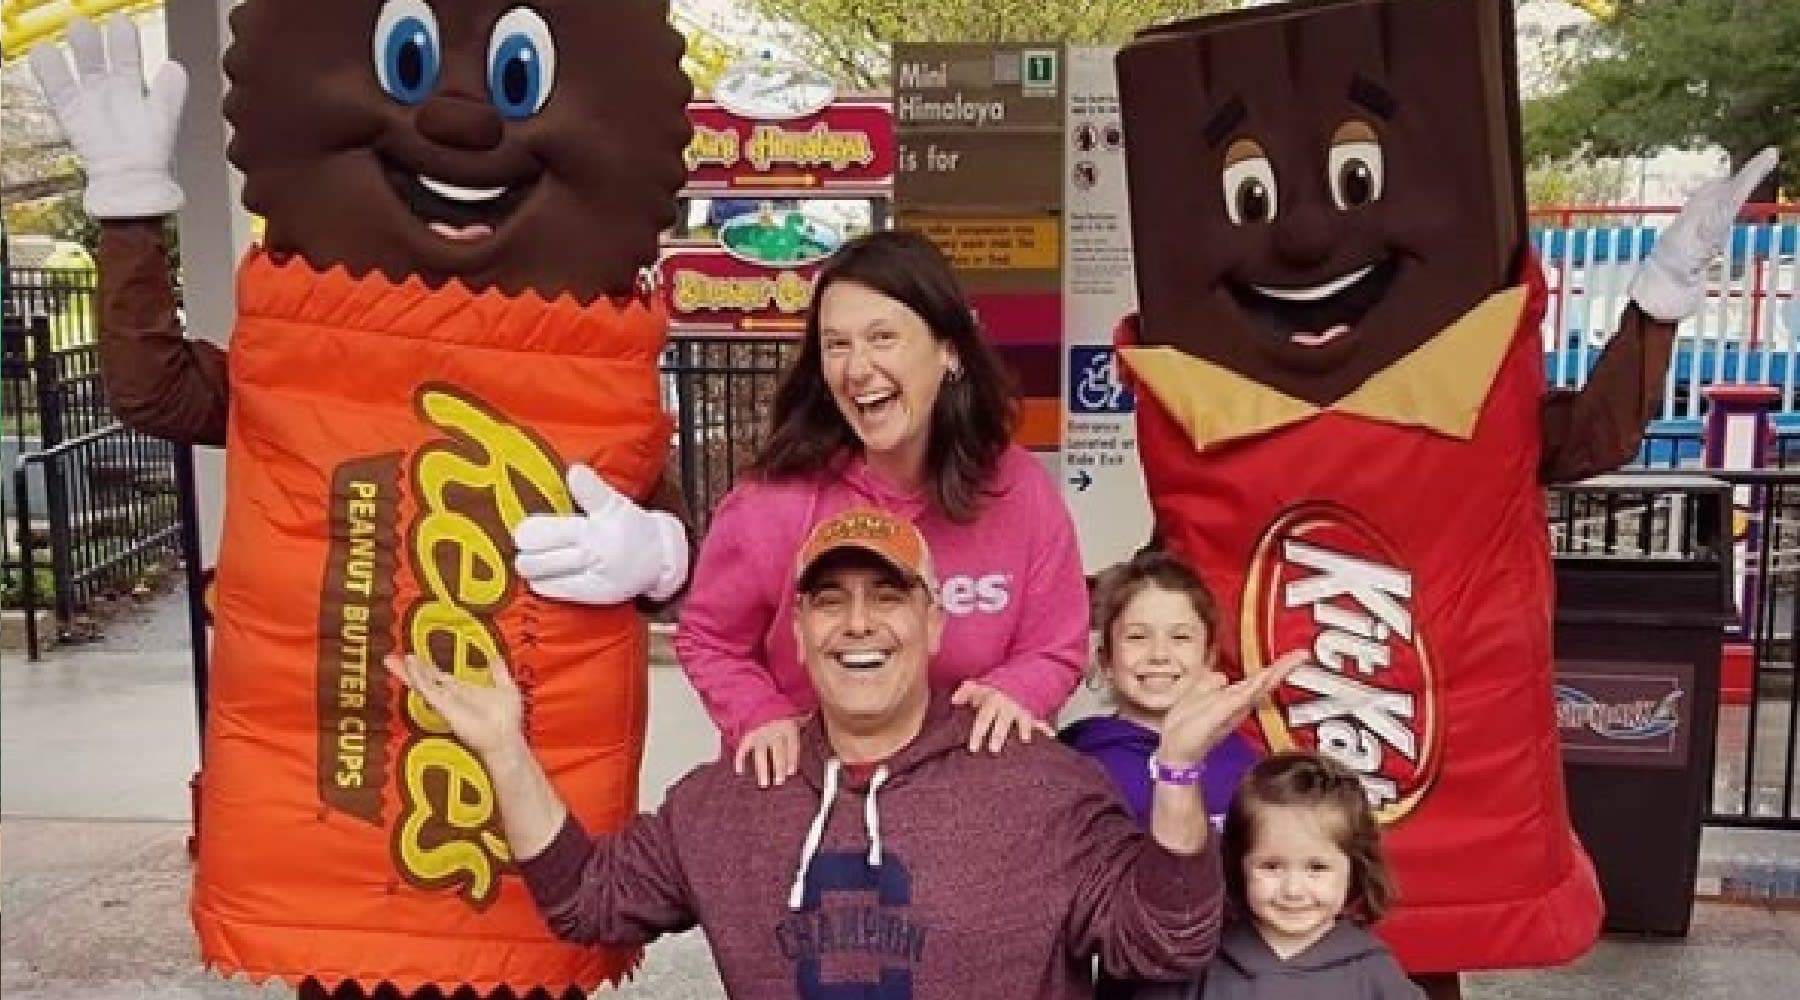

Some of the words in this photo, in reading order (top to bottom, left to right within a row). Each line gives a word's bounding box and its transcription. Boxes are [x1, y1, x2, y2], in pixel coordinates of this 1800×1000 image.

[900, 62, 947, 88] Mini
[900, 92, 1005, 127] Himalaya
[899, 145, 917, 172] is
[927, 145, 959, 172] for
[345, 479, 377, 596] PEANUT
[942, 573, 1009, 615] es
[339, 605, 371, 709] BUTTER
[400, 389, 575, 900] Reee's
[334, 716, 367, 789] CUPS
